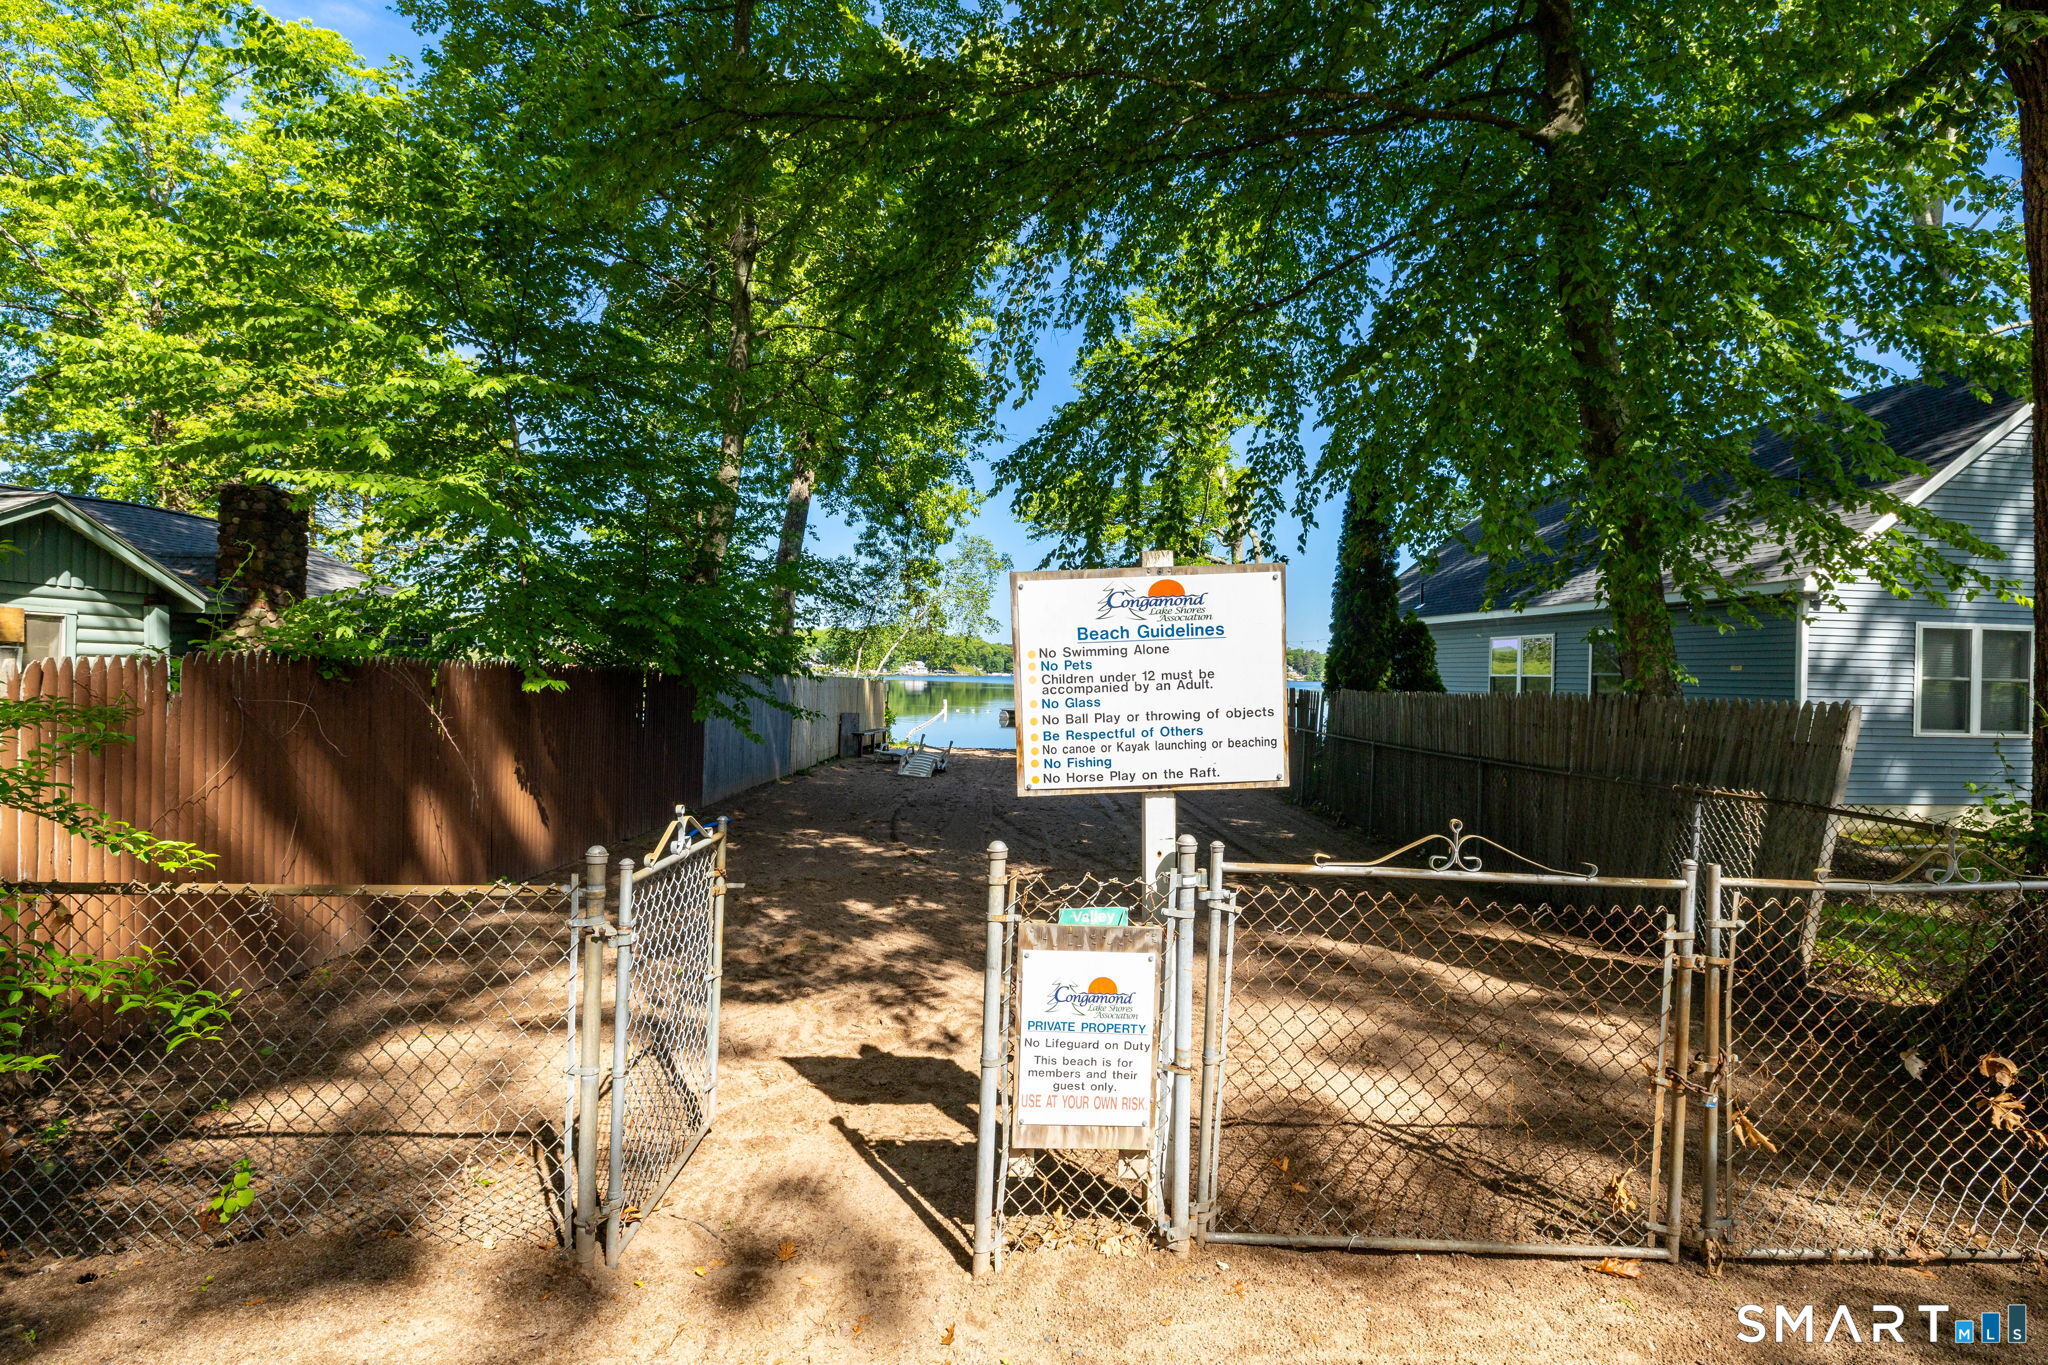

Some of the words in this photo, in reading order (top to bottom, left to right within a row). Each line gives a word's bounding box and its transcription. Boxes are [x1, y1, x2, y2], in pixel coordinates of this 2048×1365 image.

[1107, 592, 1208, 611] Congamond
[1150, 607, 1172, 615] Lake
[1158, 614, 1212, 622] Association
[1077, 627, 1129, 640] Beach
[1138, 624, 1225, 638] Guidelines
[1039, 648, 1056, 658] No
[1063, 646, 1128, 658] Swimming
[1134, 645, 1169, 654] Alone
[1041, 661, 1058, 671] No
[1064, 660, 1092, 670] Pets
[1042, 673, 1094, 685] Children
[1100, 672, 1135, 682] under
[1142, 671, 1155, 681] 12
[1161, 671, 1192, 680] must
[1199, 669, 1215, 679] be
[1042, 682, 1128, 695] accompanied
[1135, 682, 1149, 693] by
[1156, 682, 1171, 691] an
[1177, 680, 1213, 690] Adult.
[1041, 699, 1059, 709] No
[1065, 697, 1101, 708] Glass
[1042, 715, 1059, 725] No
[1066, 714, 1089, 724] Ball
[1095, 712, 1120, 724] Play
[1127, 713, 1139, 722] or
[1146, 710, 1201, 723] throwing
[1207, 709, 1219, 719] of
[1226, 707, 1274, 719] objects
[1043, 731, 1060, 741] Be
[1066, 728, 1135, 741] Respectful
[1141, 727, 1154, 737] of
[1160, 726, 1203, 736] Others
[1042, 744, 1057, 754] No
[1062, 745, 1096, 753] canoe
[1101, 744, 1111, 752] or
[1117, 742, 1149, 753] Kayak
[1155, 739, 1206, 751] launching
[1212, 740, 1222, 748] or
[1228, 737, 1277, 748] beaching
[1044, 758, 1061, 768] No
[1067, 757, 1112, 769] Fishing
[1043, 773, 1060, 783] No
[1066, 772, 1103, 782] Horse
[1110, 770, 1136, 782] Play
[1142, 771, 1157, 780] on
[1163, 769, 1183, 779] the
[1190, 768, 1220, 778] Raft.
[1073, 910, 1115, 923] Valley
[1054, 986, 1135, 1007] Congamond
[1028, 1021, 1075, 1032] PRIVATE
[1081, 1023, 1146, 1034] PROPERTY
[1025, 1038, 1040, 1048] No
[1045, 1038, 1099, 1052] Lifeguard
[1105, 1041, 1119, 1049] on
[1124, 1040, 1150, 1052] Duty
[1034, 1056, 1057, 1065] This
[1062, 1057, 1097, 1067] beach
[1103, 1058, 1111, 1067] is
[1117, 1058, 1133, 1067] for
[1028, 1068, 1080, 1078] members
[1086, 1069, 1106, 1079] and
[1112, 1070, 1137, 1080] their
[1053, 1081, 1085, 1092] guest
[1091, 1082, 1116, 1092] only.
[1021, 1094, 1042, 1108] USE
[1046, 1095, 1059, 1108] AT
[1062, 1095, 1089, 1109] YOUR
[1094, 1096, 1117, 1110] OWN
